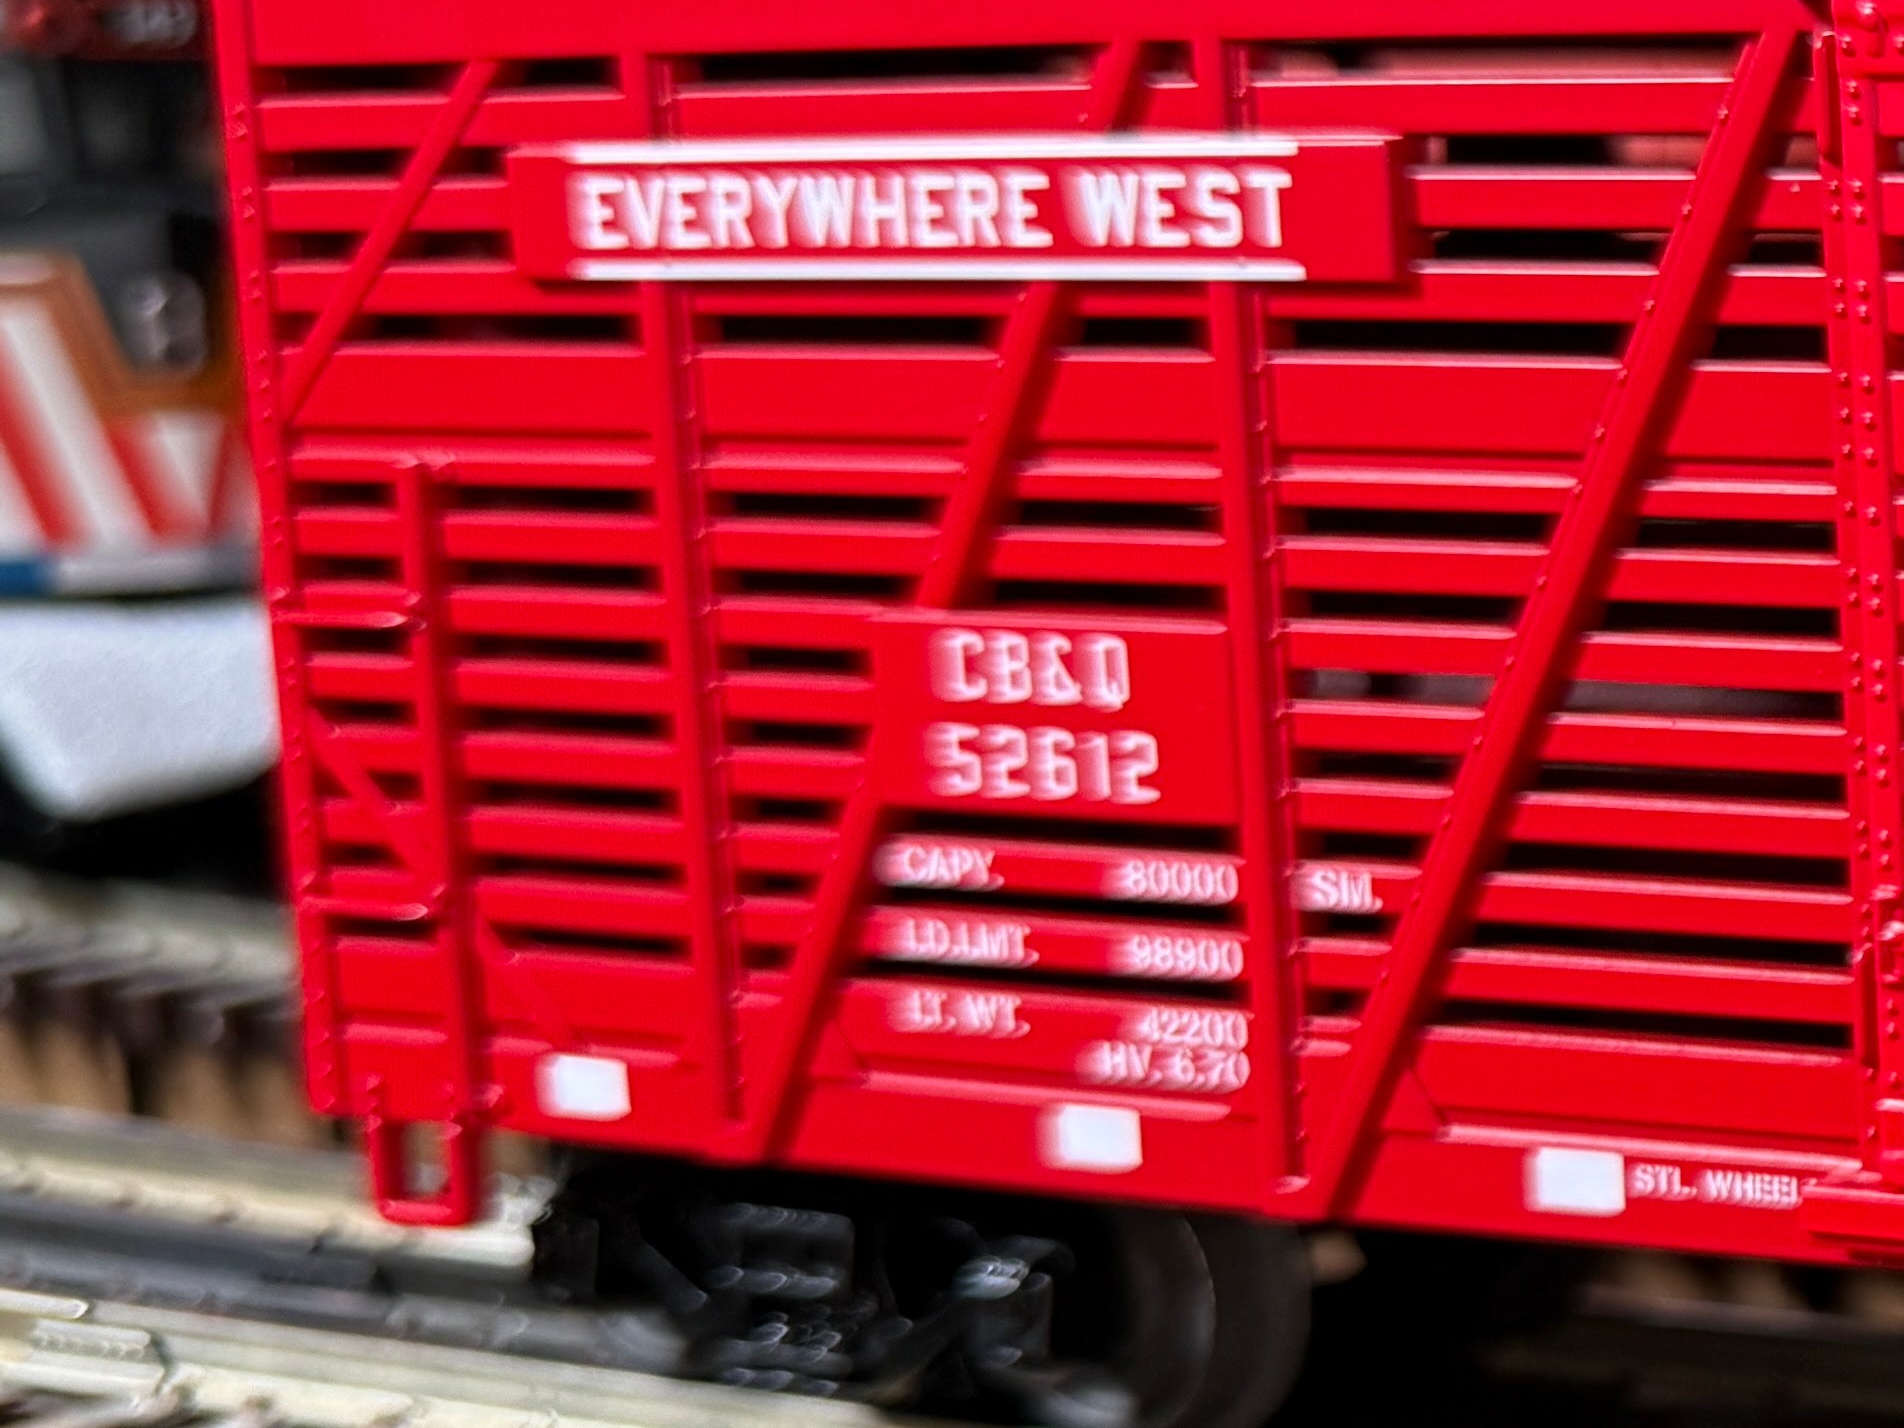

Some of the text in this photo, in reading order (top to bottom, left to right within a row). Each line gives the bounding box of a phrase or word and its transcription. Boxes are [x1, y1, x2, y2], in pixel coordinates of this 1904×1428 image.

[580, 166, 1294, 251] EVERYWHERE WEST
[932, 628, 1131, 713] CB&Q
[924, 721, 1161, 805] 52612
[885, 843, 1240, 906] CAPY. 80000
[1118, 933, 1244, 982] 98900
[1128, 1005, 1249, 1051] 42200
